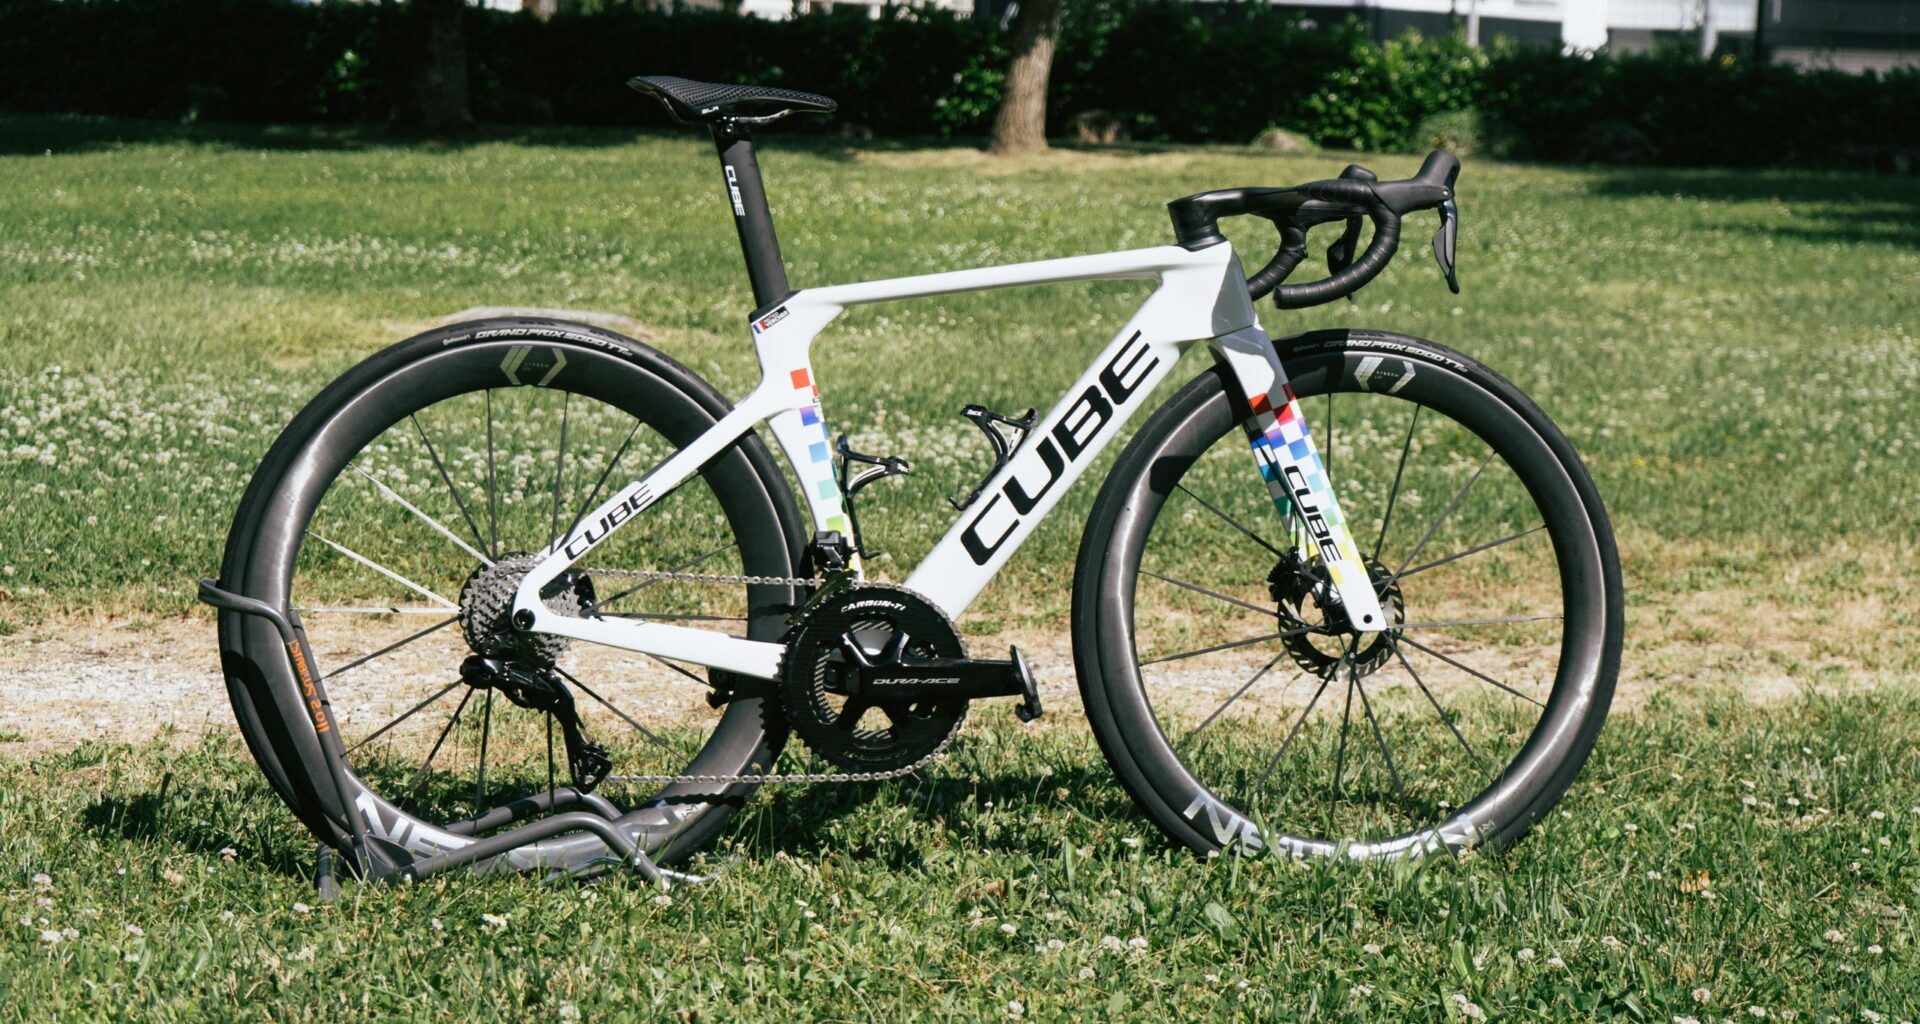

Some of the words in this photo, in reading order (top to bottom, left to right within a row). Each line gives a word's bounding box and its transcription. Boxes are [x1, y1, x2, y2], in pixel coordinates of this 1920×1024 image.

[725, 165, 745, 216] CUBE
[475, 328, 528, 339] GRAND
[526, 328, 566, 338] PRIX
[563, 332, 608, 347] 5000
[1323, 340, 1372, 348] GRAND
[1370, 341, 1408, 351] PRIX
[1405, 346, 1446, 362] 5000
[960, 328, 1160, 566] CUBE
[564, 483, 654, 561] CUBE
[1284, 465, 1343, 563] CUBE
[841, 599, 906, 613] CARBON-TI
[872, 677, 961, 685] DURA-ACE
